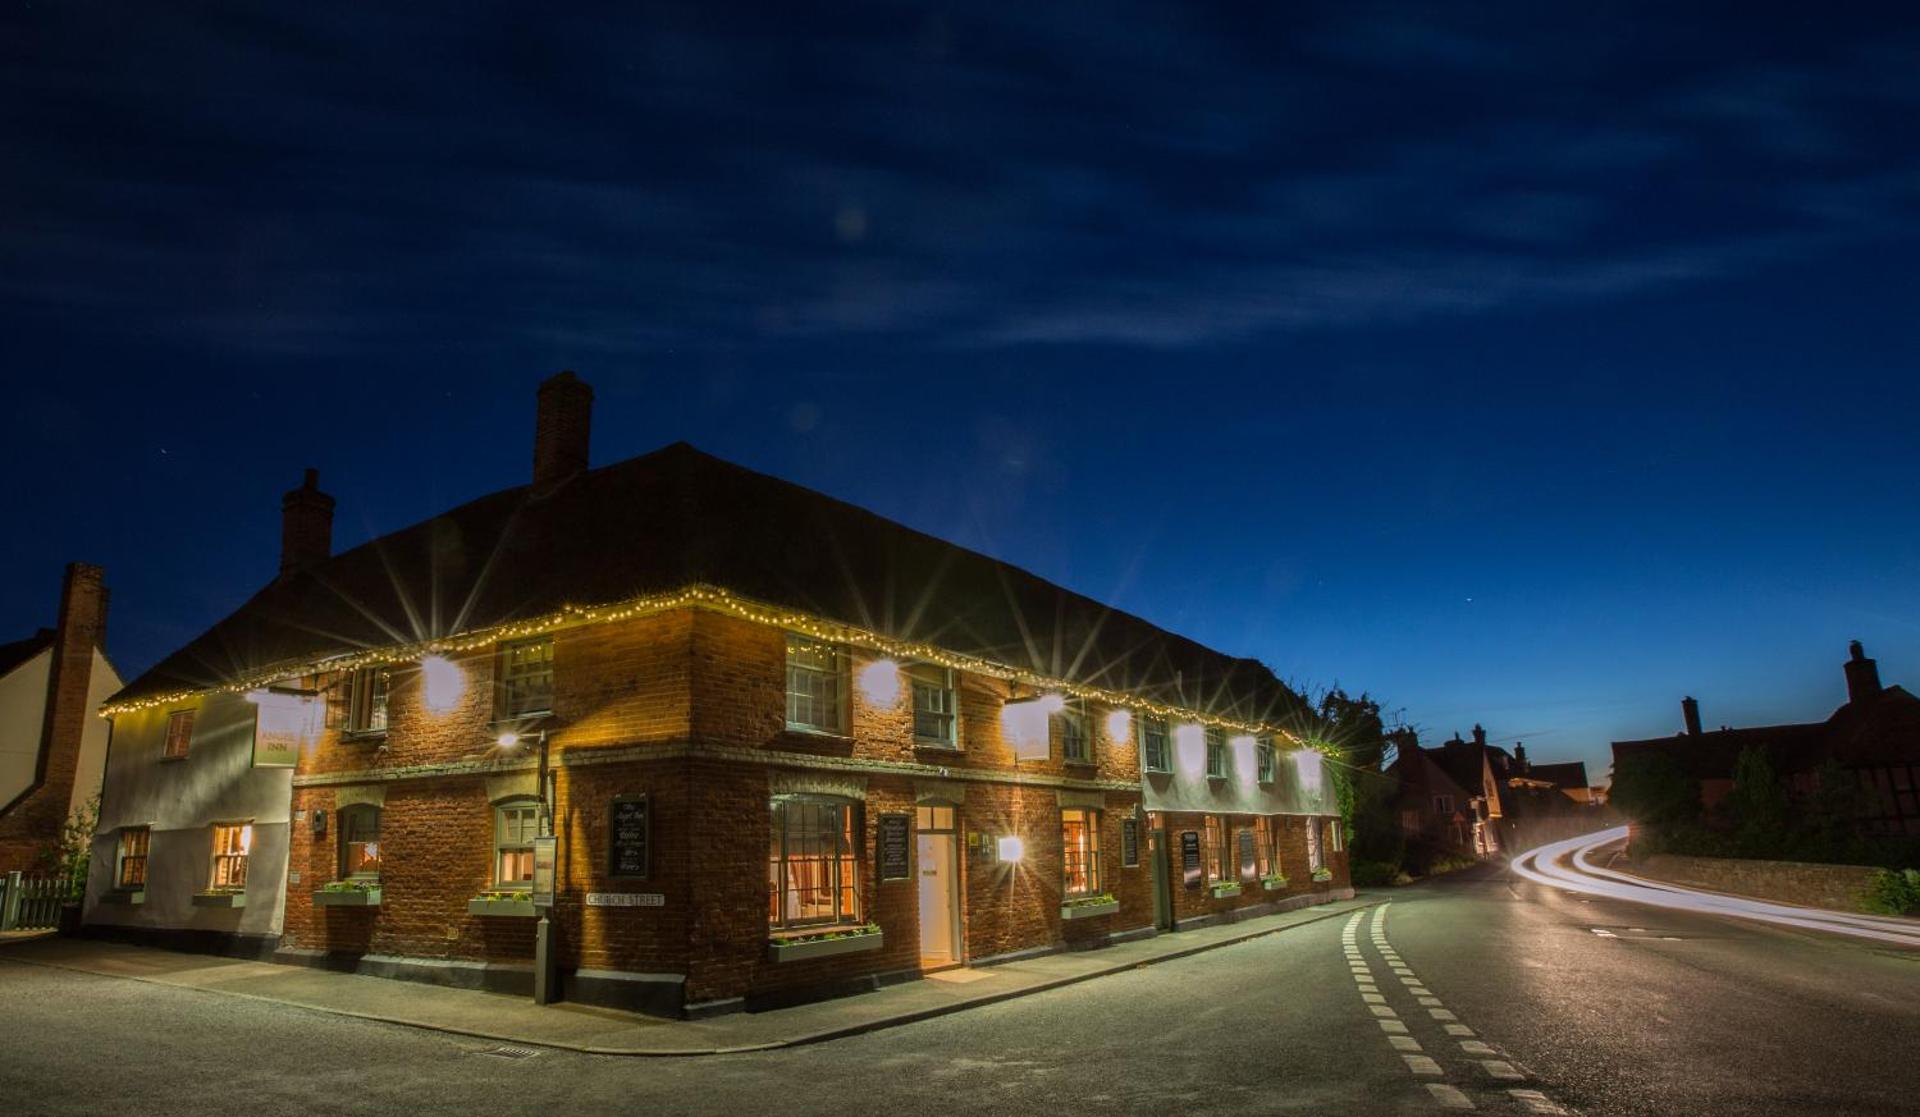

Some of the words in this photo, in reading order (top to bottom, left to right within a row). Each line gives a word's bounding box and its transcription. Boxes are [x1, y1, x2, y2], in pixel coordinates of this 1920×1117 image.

[267, 743, 288, 752] INN
[588, 894, 625, 905] CHURCH
[628, 894, 662, 905] STREET
